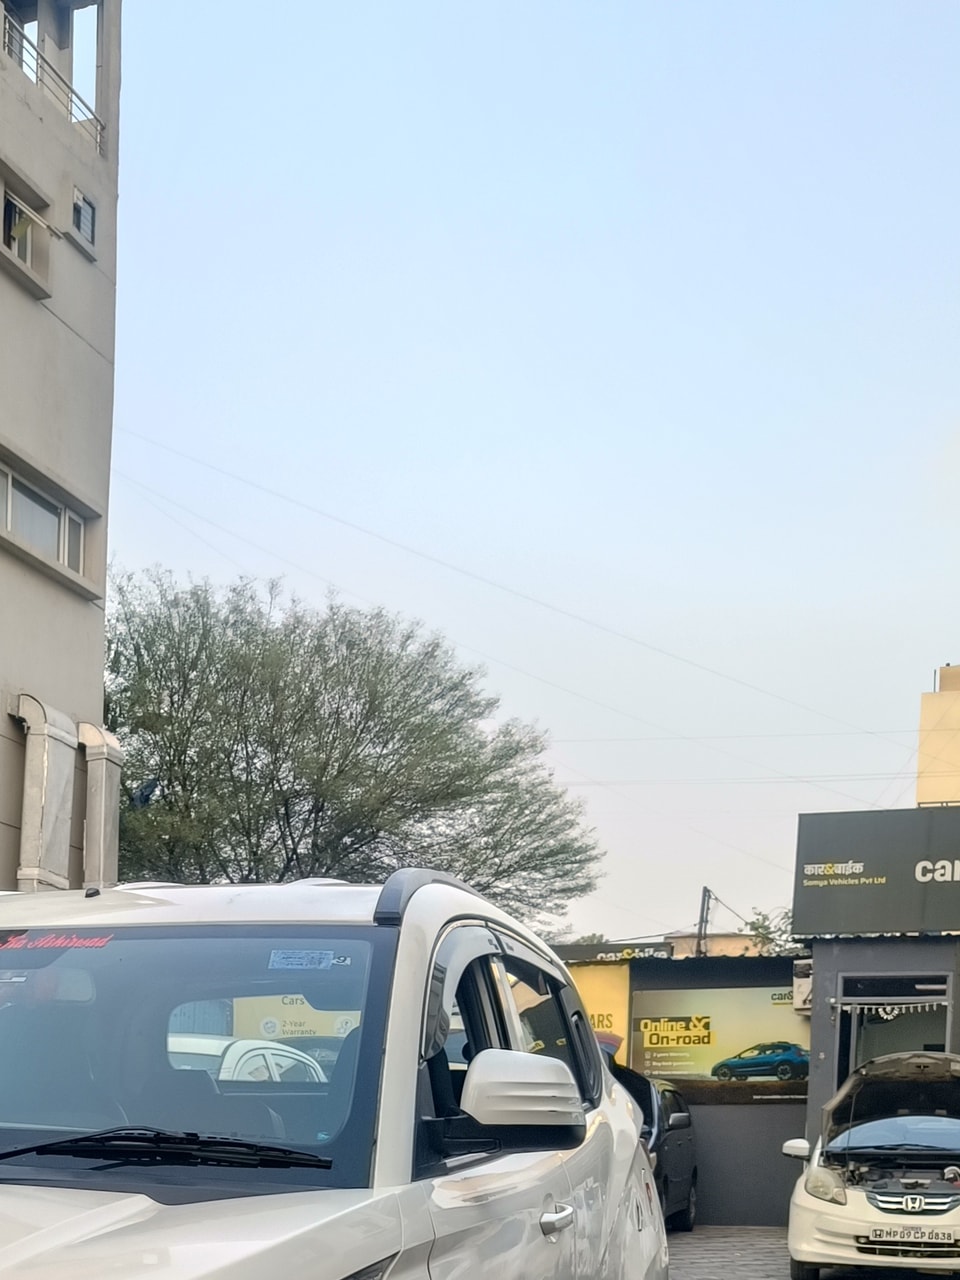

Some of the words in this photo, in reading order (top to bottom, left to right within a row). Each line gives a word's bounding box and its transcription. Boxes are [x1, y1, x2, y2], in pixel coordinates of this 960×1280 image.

[829, 877, 859, 886] Vehicles
[860, 877, 873, 885] Pvt
[874, 876, 886, 885] Ltd
[281, 995, 305, 1006] Cars
[282, 1020, 306, 1028] 2-Year
[640, 1017, 686, 1032] Online
[688, 1014, 711, 1032] &
[282, 1028, 317, 1036] Warranty
[649, 1031, 711, 1046] On-road
